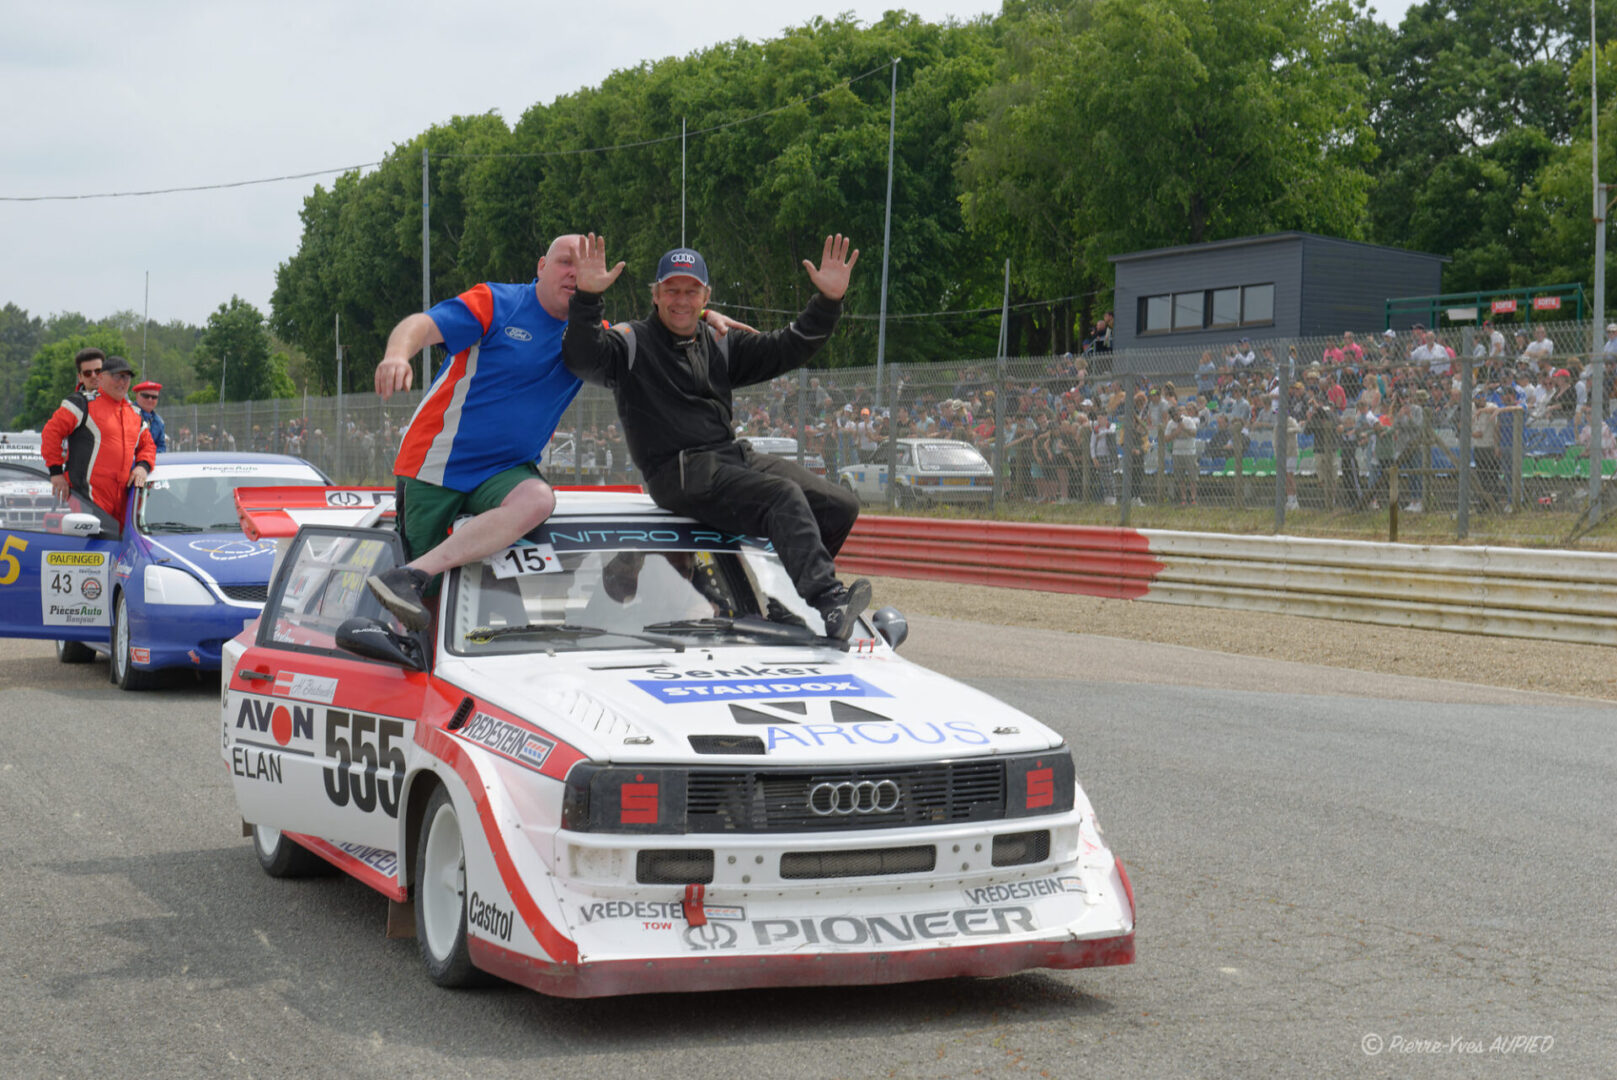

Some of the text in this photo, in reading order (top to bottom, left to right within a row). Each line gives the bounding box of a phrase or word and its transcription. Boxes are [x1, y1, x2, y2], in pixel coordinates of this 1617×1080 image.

[550, 530, 753, 544] NITRO RX
[49, 554, 101, 564] PALFINGER
[505, 547, 546, 574] 15
[51, 573, 72, 594] 43
[662, 681, 861, 696] STANDOX
[235, 698, 314, 746] AVON
[767, 721, 990, 750] ARCUS
[232, 747, 283, 784] ELAN
[322, 709, 406, 819] 555
[965, 878, 1065, 905] VREDESTEIN
[469, 891, 514, 942] Castrol
[580, 901, 682, 922] VREDESTE
[642, 921, 673, 931] TOW
[751, 906, 1037, 946] PIONEER
